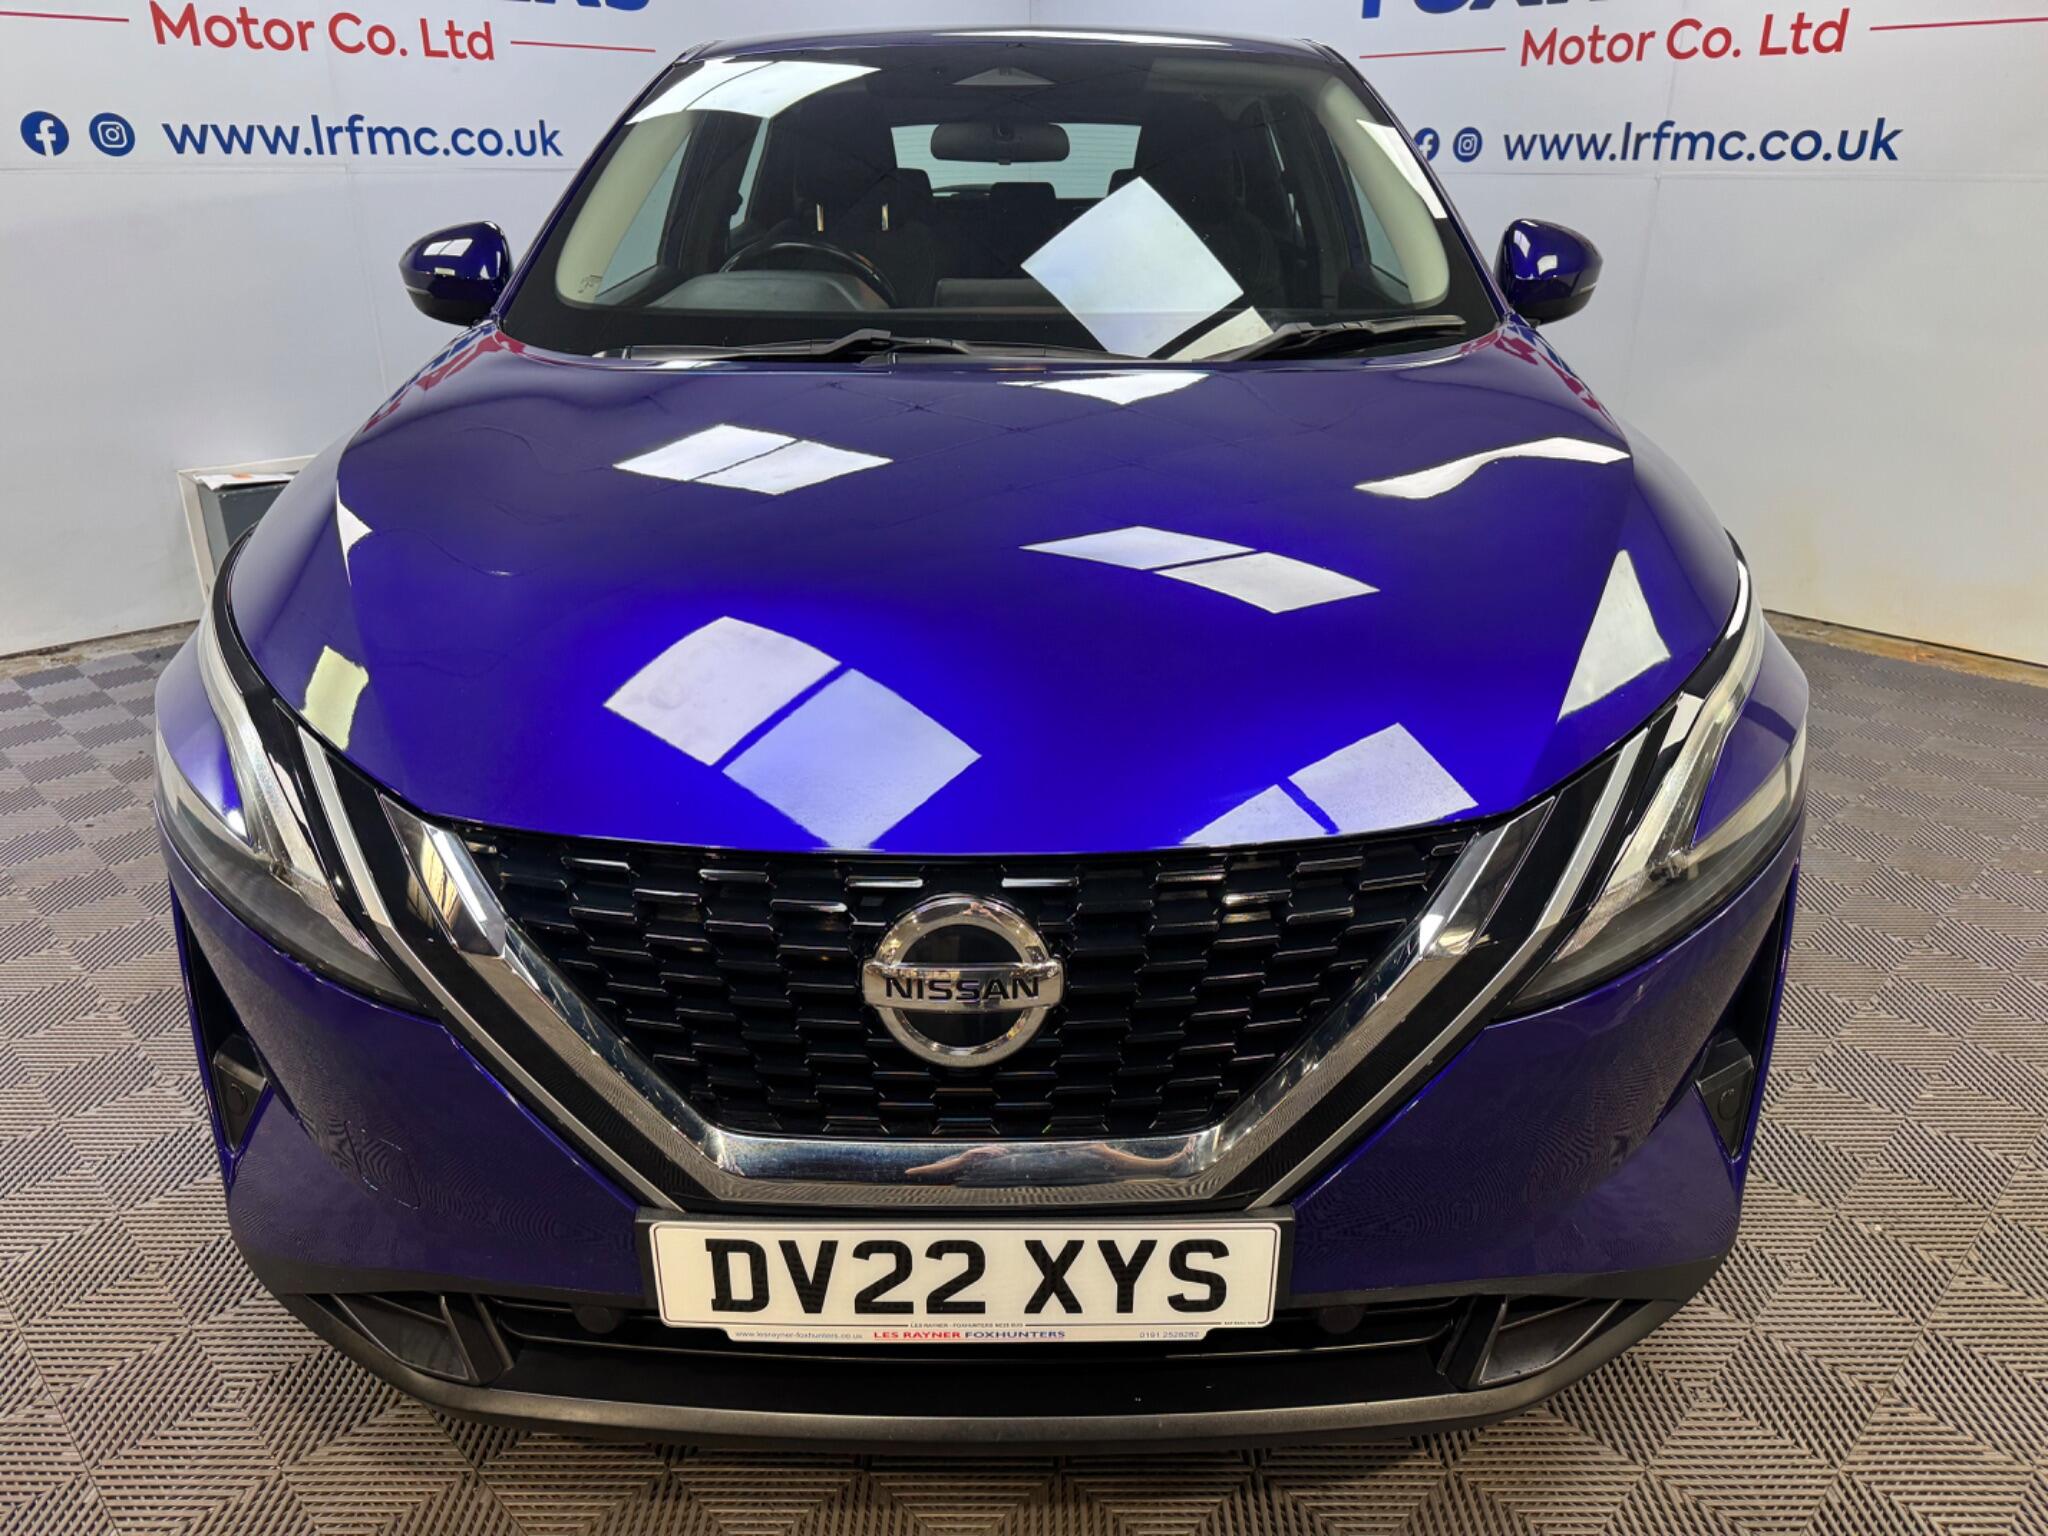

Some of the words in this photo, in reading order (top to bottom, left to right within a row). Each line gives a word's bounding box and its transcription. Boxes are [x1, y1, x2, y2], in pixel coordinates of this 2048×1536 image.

[150, 0, 315, 51] Motor
[328, 13, 407, 56] Co.
[420, 17, 494, 61] Ltd
[1520, 25, 1655, 66] Motor
[1665, 18, 1741, 60] Co.
[1760, 8, 1850, 56] Ltd
[163, 114, 562, 157] www.lrfmc.co.uk
[1504, 117, 1903, 162] www.lrfmc.co.uk
[884, 975, 1040, 1000] NISSAN
[704, 1238, 987, 1315] DV22
[1023, 1239, 1231, 1314] XYS
[873, 1331, 899, 1340] LES
[903, 1331, 961, 1340] RAYNER
[964, 1331, 1066, 1341] FOXHUNTERS
